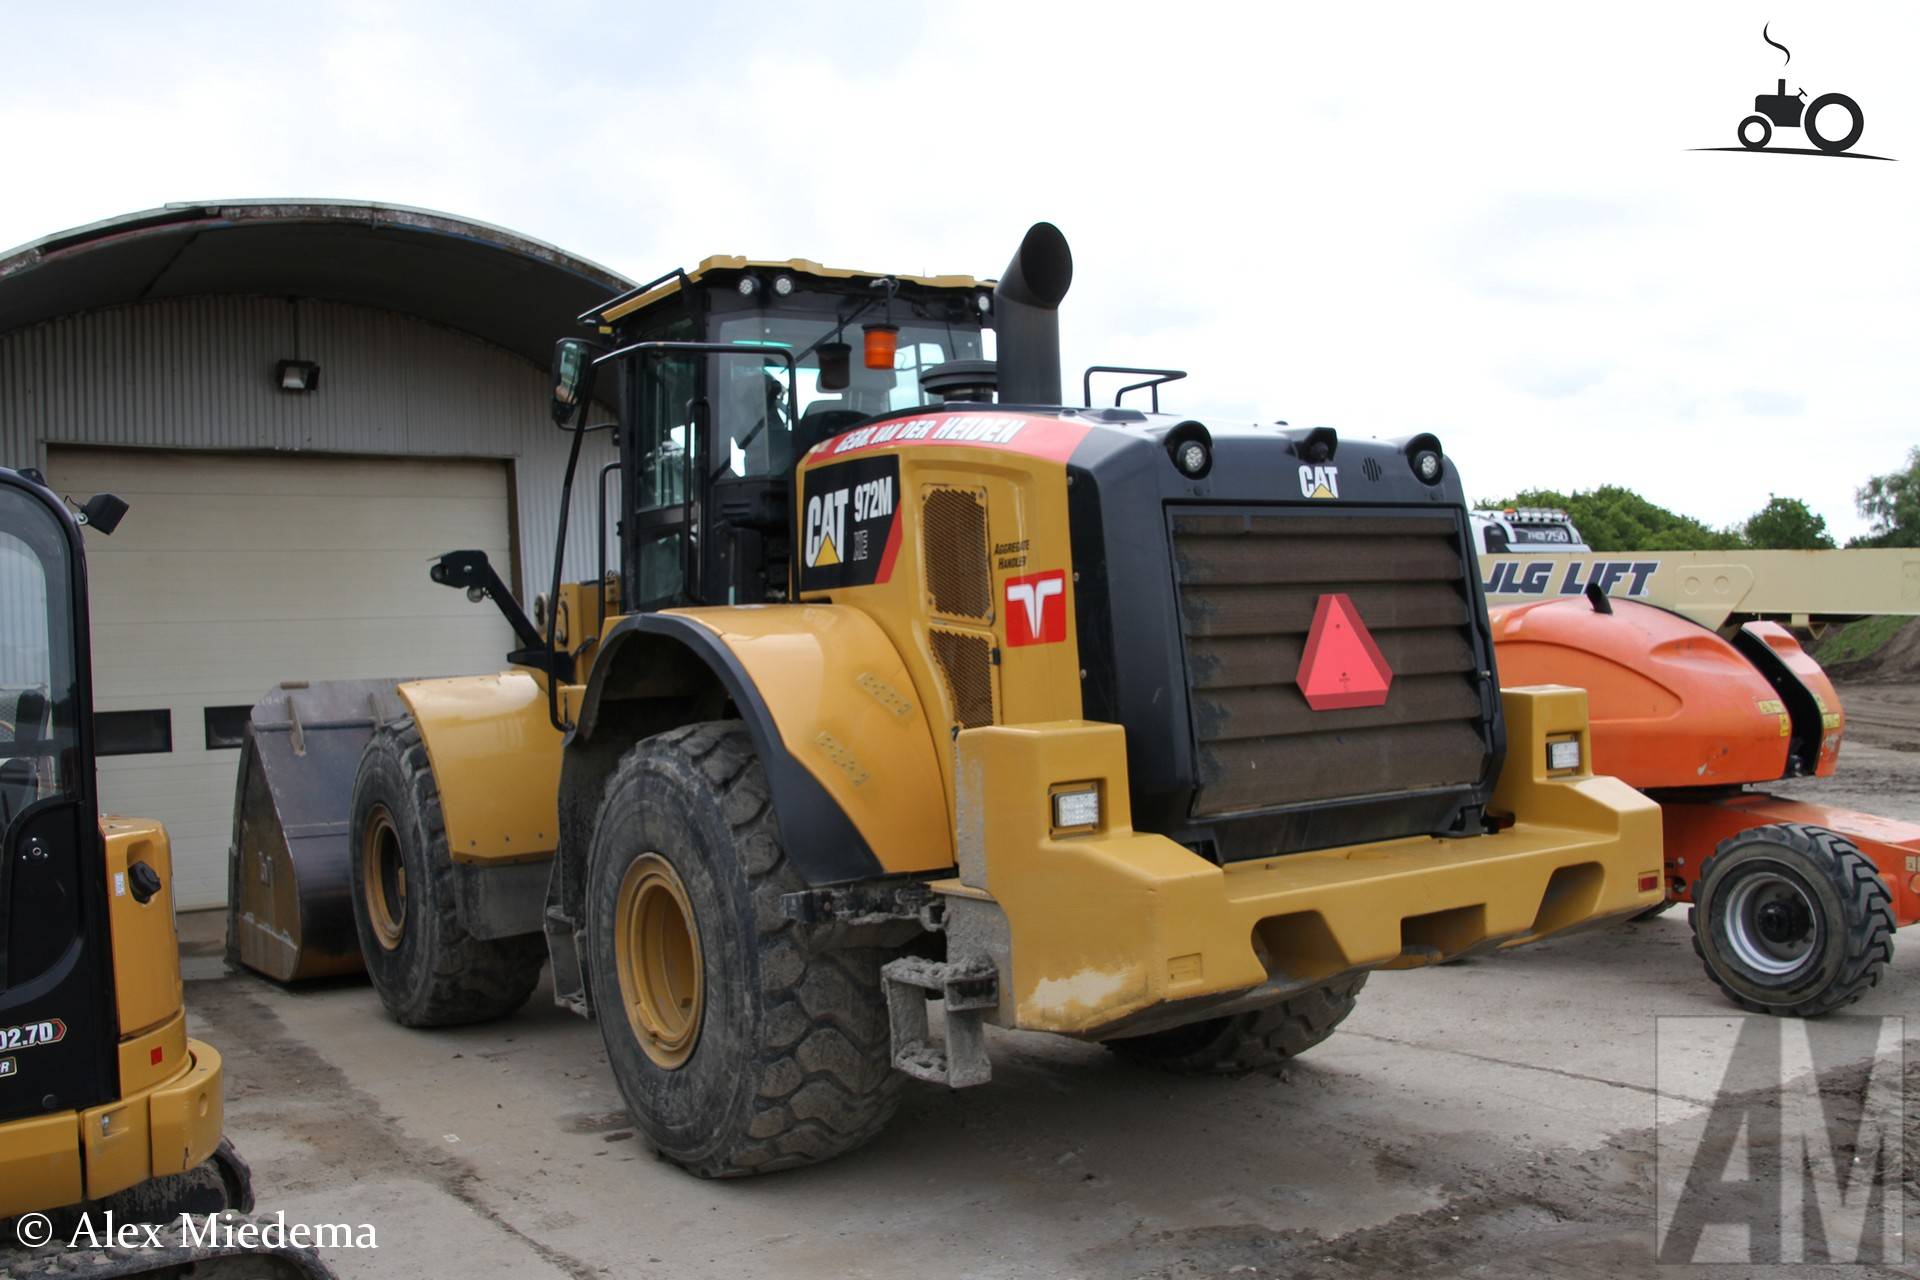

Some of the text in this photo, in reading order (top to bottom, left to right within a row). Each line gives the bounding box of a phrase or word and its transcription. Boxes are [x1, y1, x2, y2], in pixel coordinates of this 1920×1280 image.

[896, 420, 937, 440] DER
[932, 416, 1026, 444] HEIDEN
[854, 476, 892, 522] 972M
[1299, 465, 1339, 499] CAT
[805, 488, 849, 568] CAT
[1482, 562, 1658, 595] JLG LIFT
